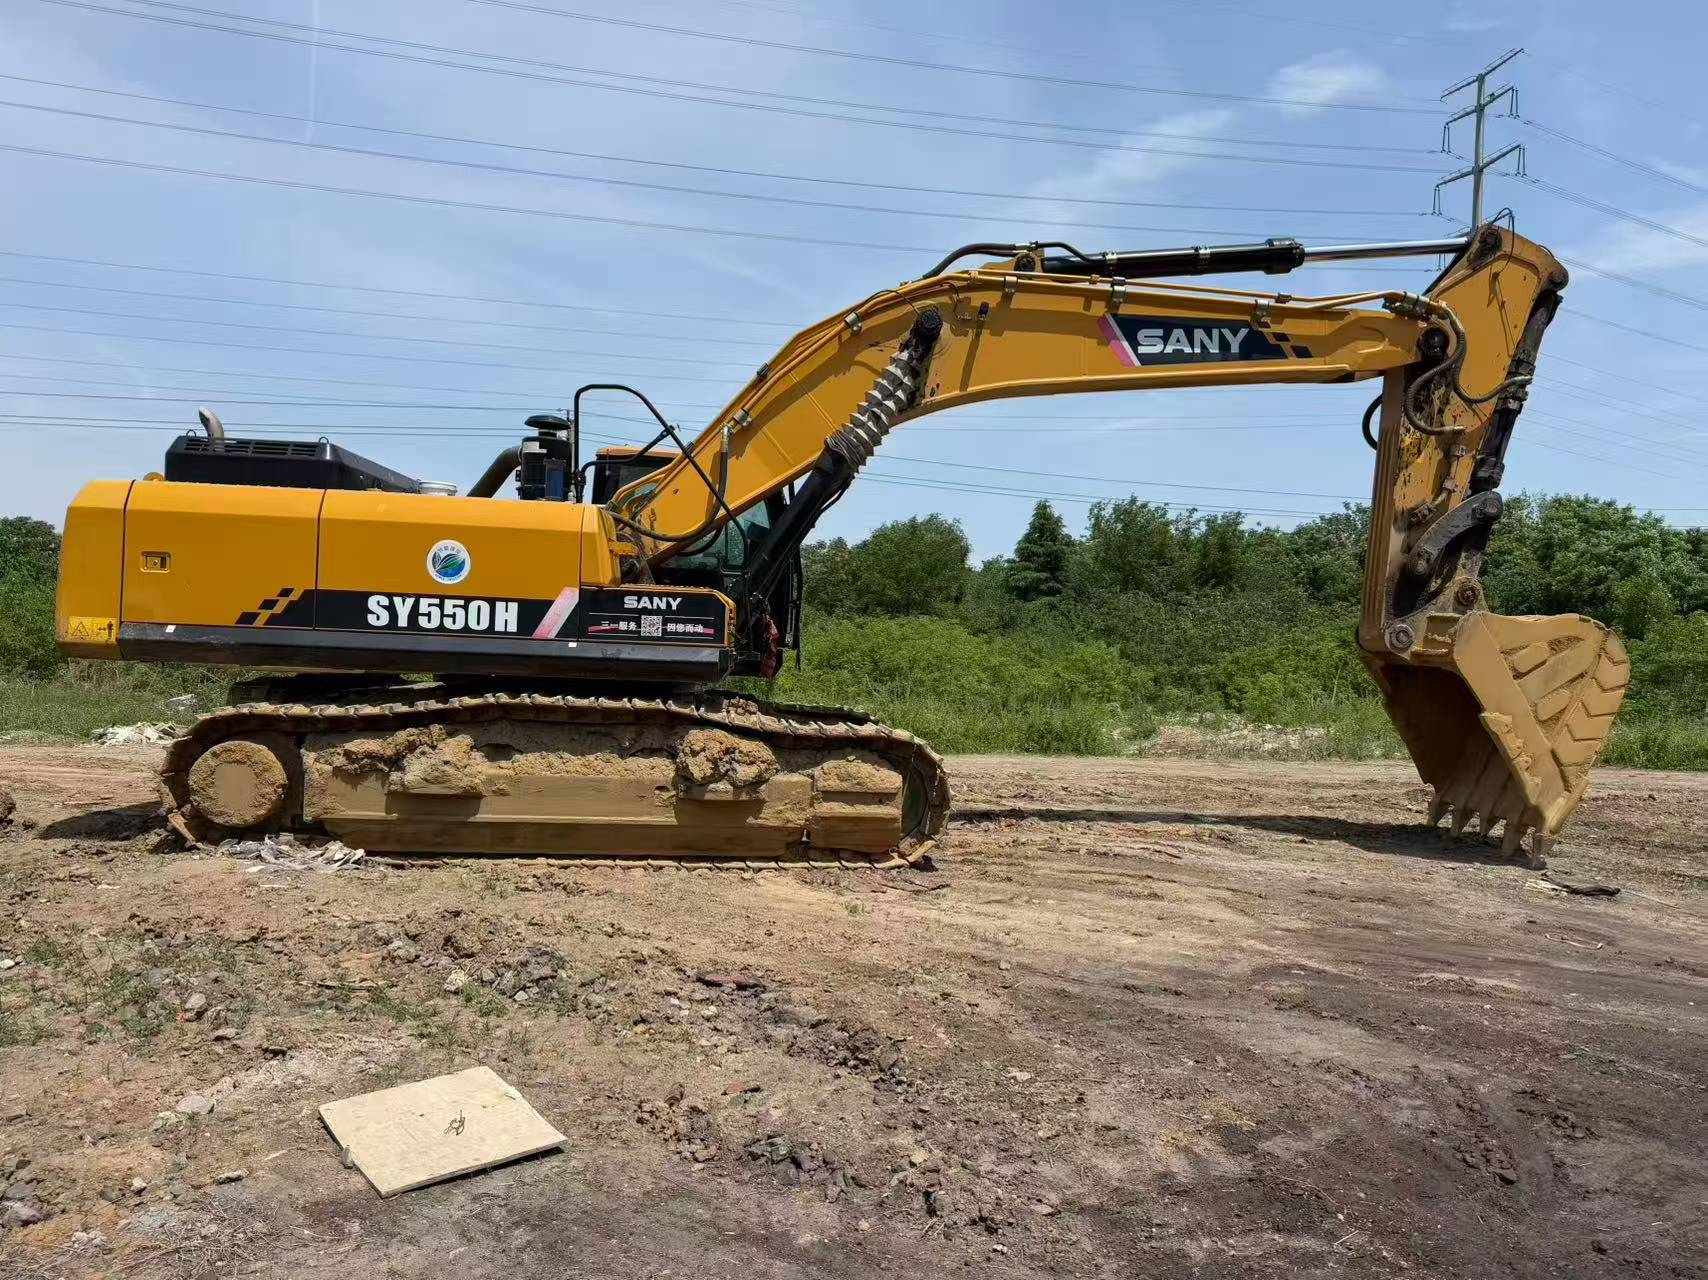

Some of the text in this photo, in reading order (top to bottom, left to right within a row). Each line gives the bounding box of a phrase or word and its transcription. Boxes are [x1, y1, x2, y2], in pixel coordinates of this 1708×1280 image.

[1137, 328, 1249, 353] SANY
[624, 596, 682, 610] SANY
[367, 595, 519, 632] SY550H
[601, 621, 637, 631] 三一服务
